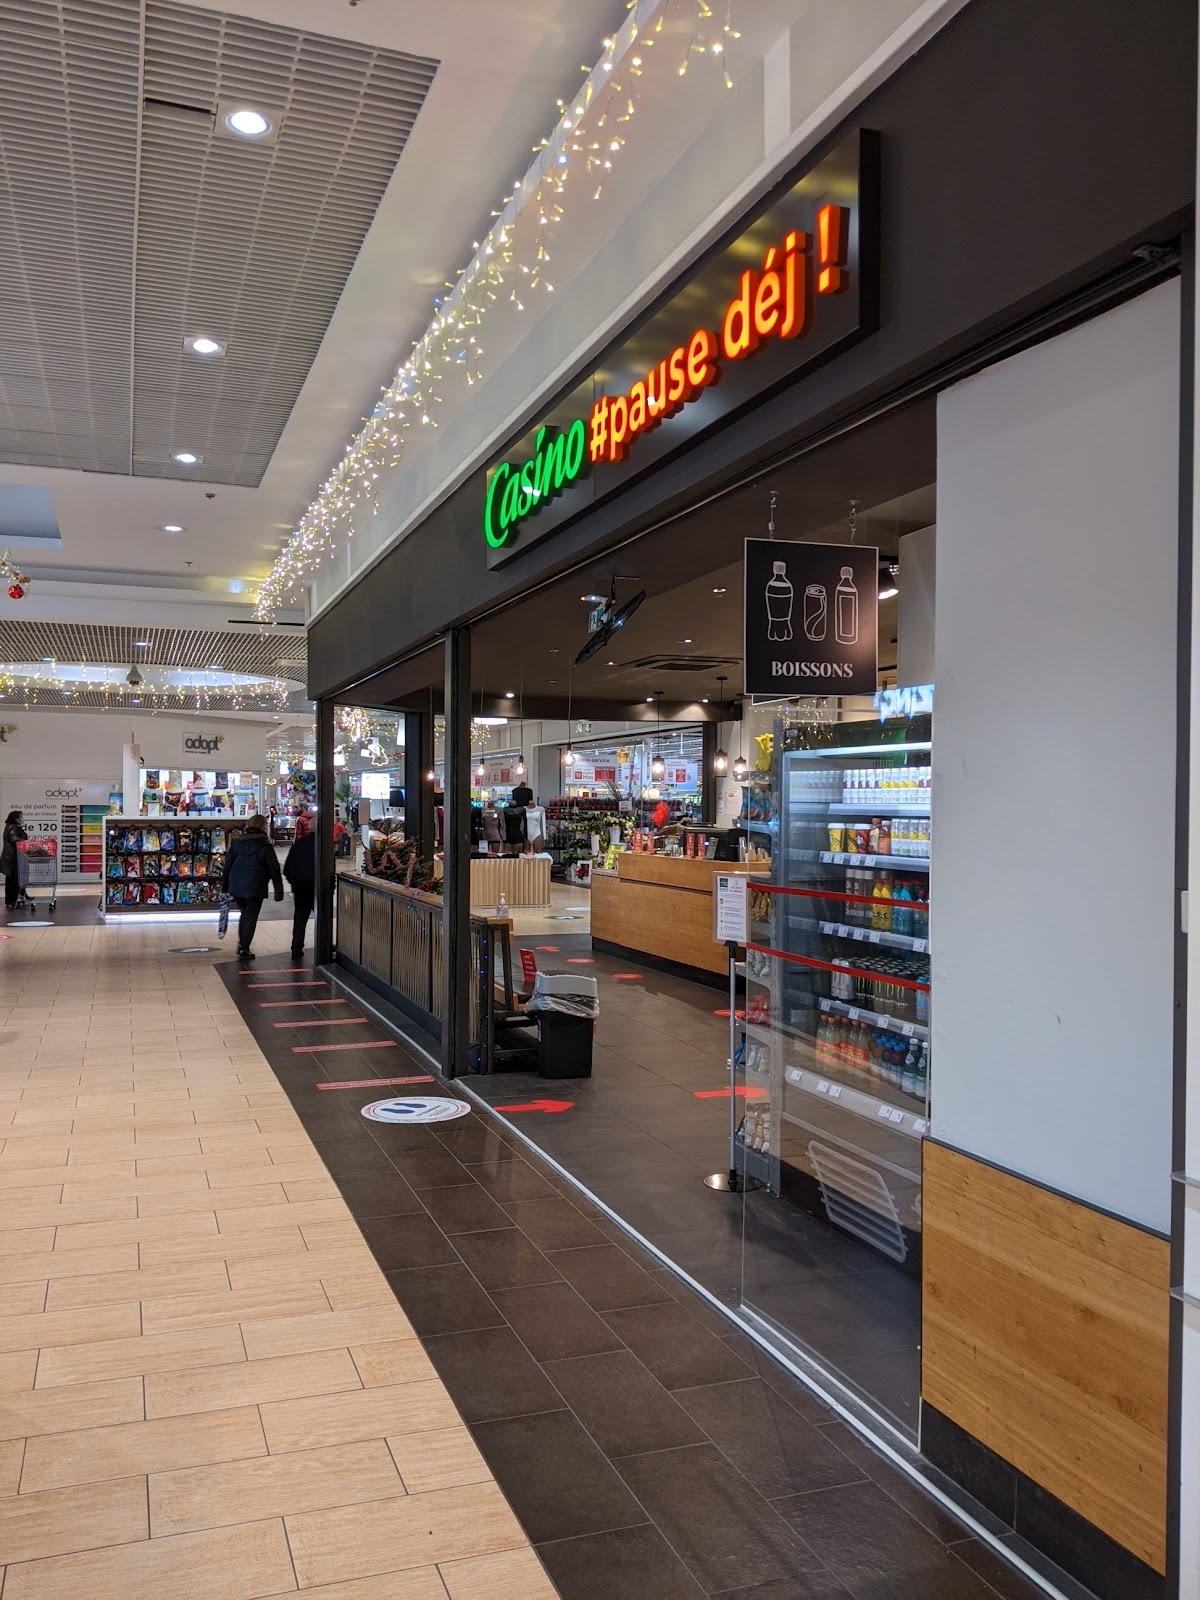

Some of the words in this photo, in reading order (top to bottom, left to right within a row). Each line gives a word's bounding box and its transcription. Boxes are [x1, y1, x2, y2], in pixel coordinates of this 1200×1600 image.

[485, 419, 585, 548] Casino
[590, 329, 711, 461] #pause
[723, 229, 808, 359] déj
[771, 661, 854, 678] BOISSONS
[186, 735, 220, 754] adopt
[45, 787, 79, 800] adopt
[21, 823, 34, 832] de
[38, 823, 58, 832] 120
